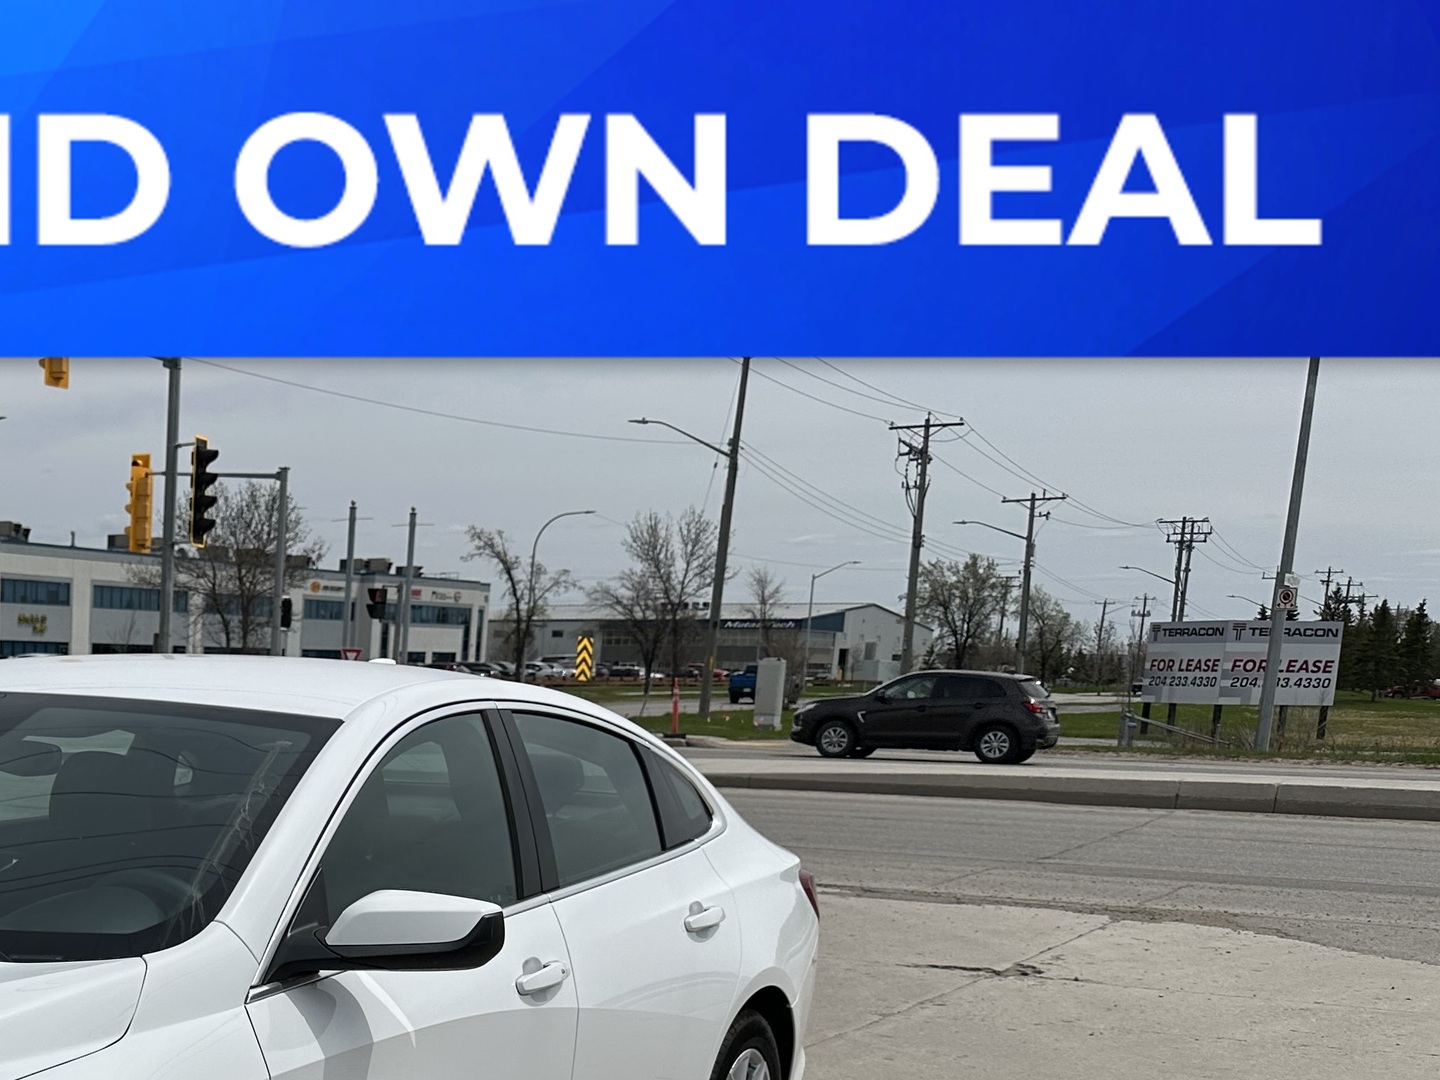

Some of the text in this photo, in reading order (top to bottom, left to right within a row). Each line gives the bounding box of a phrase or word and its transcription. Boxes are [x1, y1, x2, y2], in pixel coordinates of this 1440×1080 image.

[1162, 627, 1225, 638] TERRACON
[1249, 627, 1339, 638] TERACON
[1150, 658, 1220, 673] FOR LEASE
[1231, 659, 1268, 673] FOR
[1148, 676, 1218, 688] 204.233.4330
